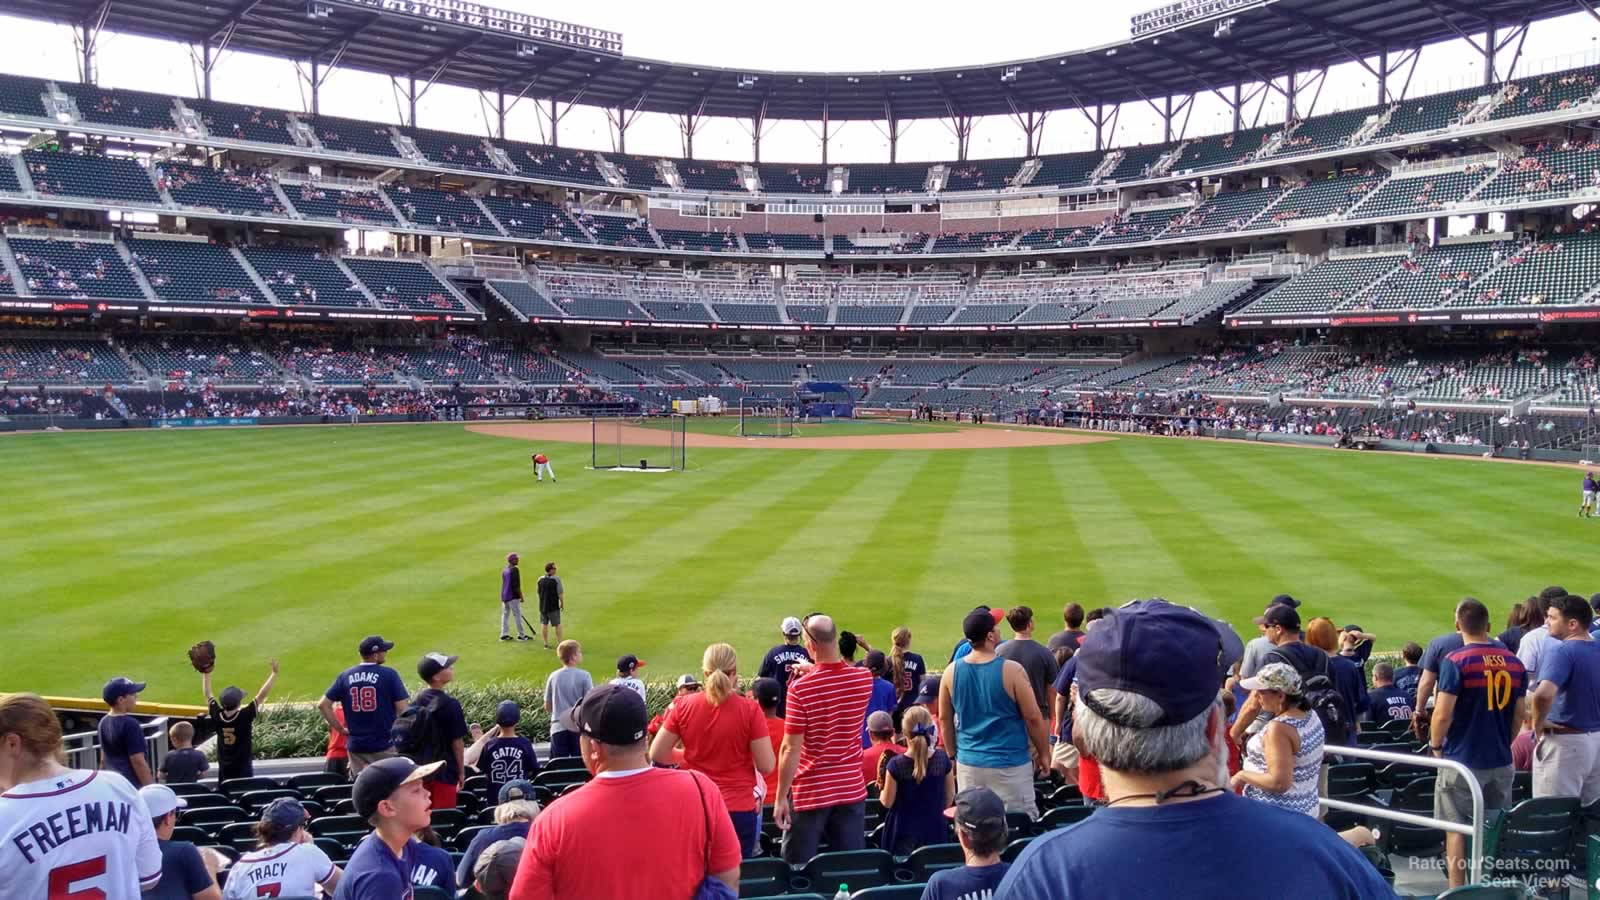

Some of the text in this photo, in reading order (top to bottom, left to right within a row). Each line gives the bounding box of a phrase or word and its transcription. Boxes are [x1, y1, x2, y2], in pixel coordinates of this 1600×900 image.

[1482, 655, 1507, 668] MESSI
[349, 671, 380, 685] ADAMS
[350, 686, 378, 712] 18
[1483, 669, 1512, 711] 10
[492, 746, 523, 760] GATTIS
[491, 759, 524, 784] 24
[13, 801, 131, 864] FREEMAN
[247, 862, 287, 884] TRACY
